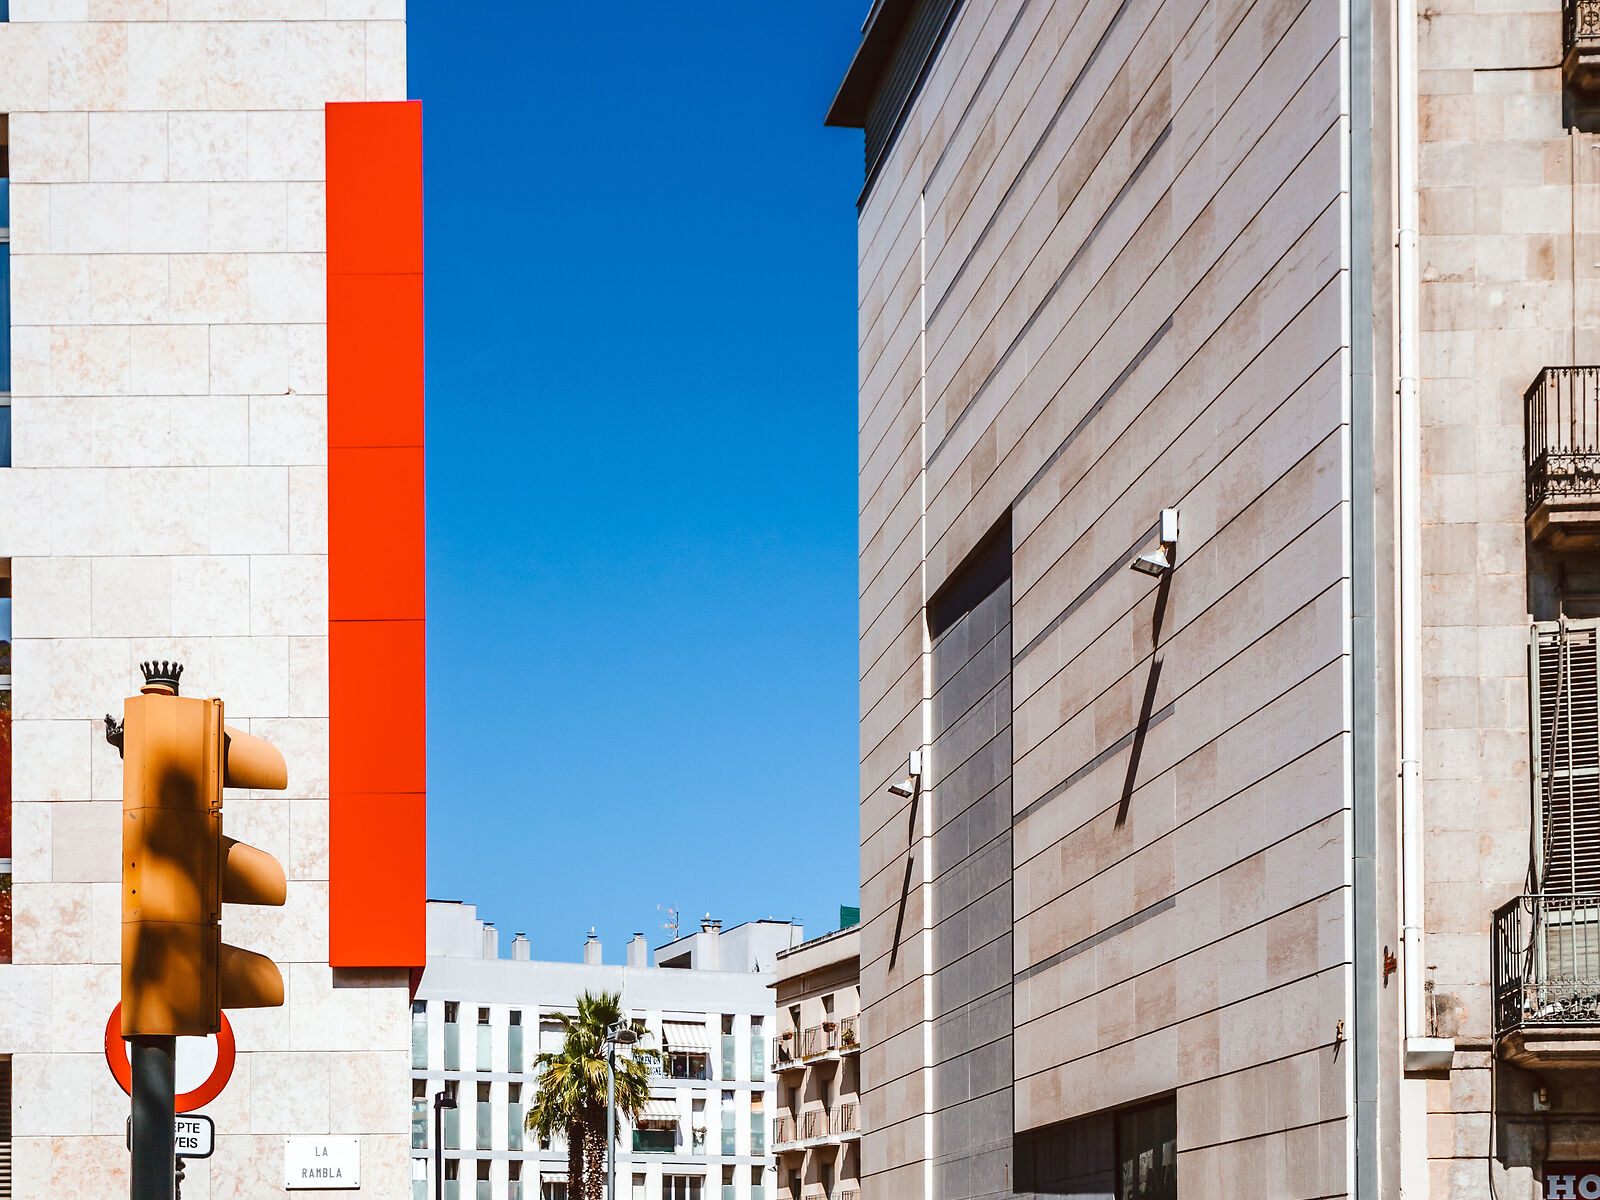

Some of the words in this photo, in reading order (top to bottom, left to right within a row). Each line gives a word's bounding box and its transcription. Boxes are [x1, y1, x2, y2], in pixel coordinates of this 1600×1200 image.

[174, 1122, 200, 1133] PTE
[315, 1146, 328, 1157] LA
[302, 1167, 342, 1178] RAMBLA
[1546, 1174, 1600, 1200] HO
